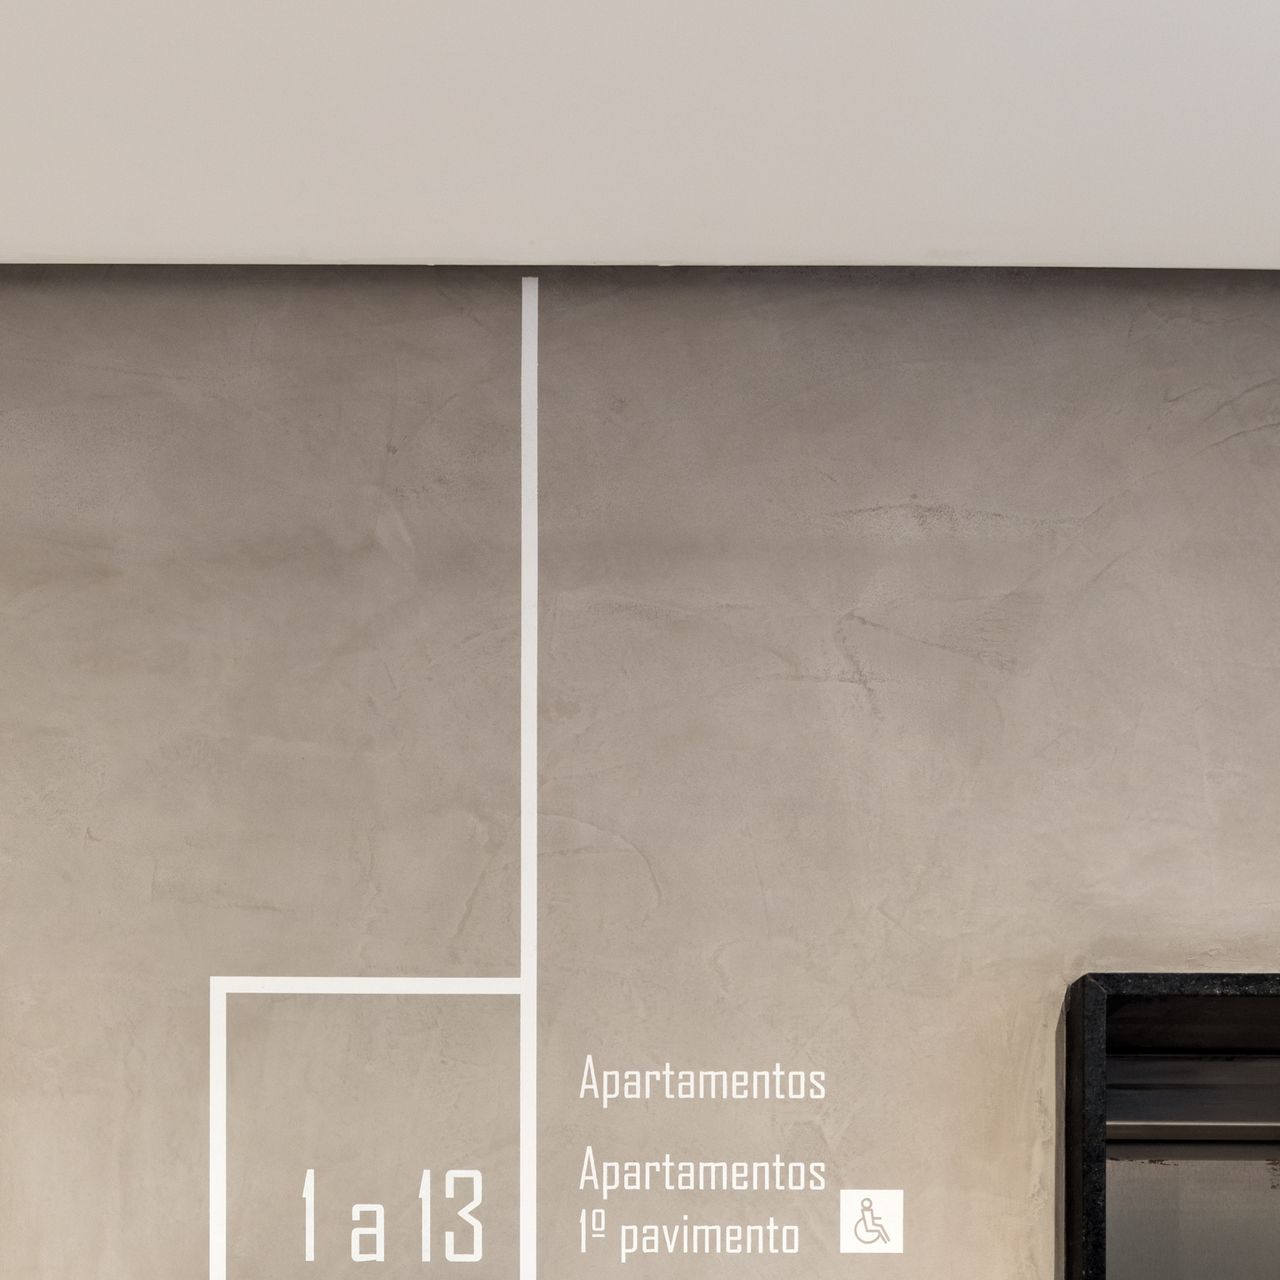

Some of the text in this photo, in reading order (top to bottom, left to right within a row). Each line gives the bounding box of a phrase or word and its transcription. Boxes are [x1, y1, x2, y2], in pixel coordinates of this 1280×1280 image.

[579, 1055, 826, 1108] Apartamentos
[579, 1146, 826, 1200] Apartamentos
[301, 1168, 483, 1263] 1 a 13
[579, 1209, 799, 1264] 1º pavimento
